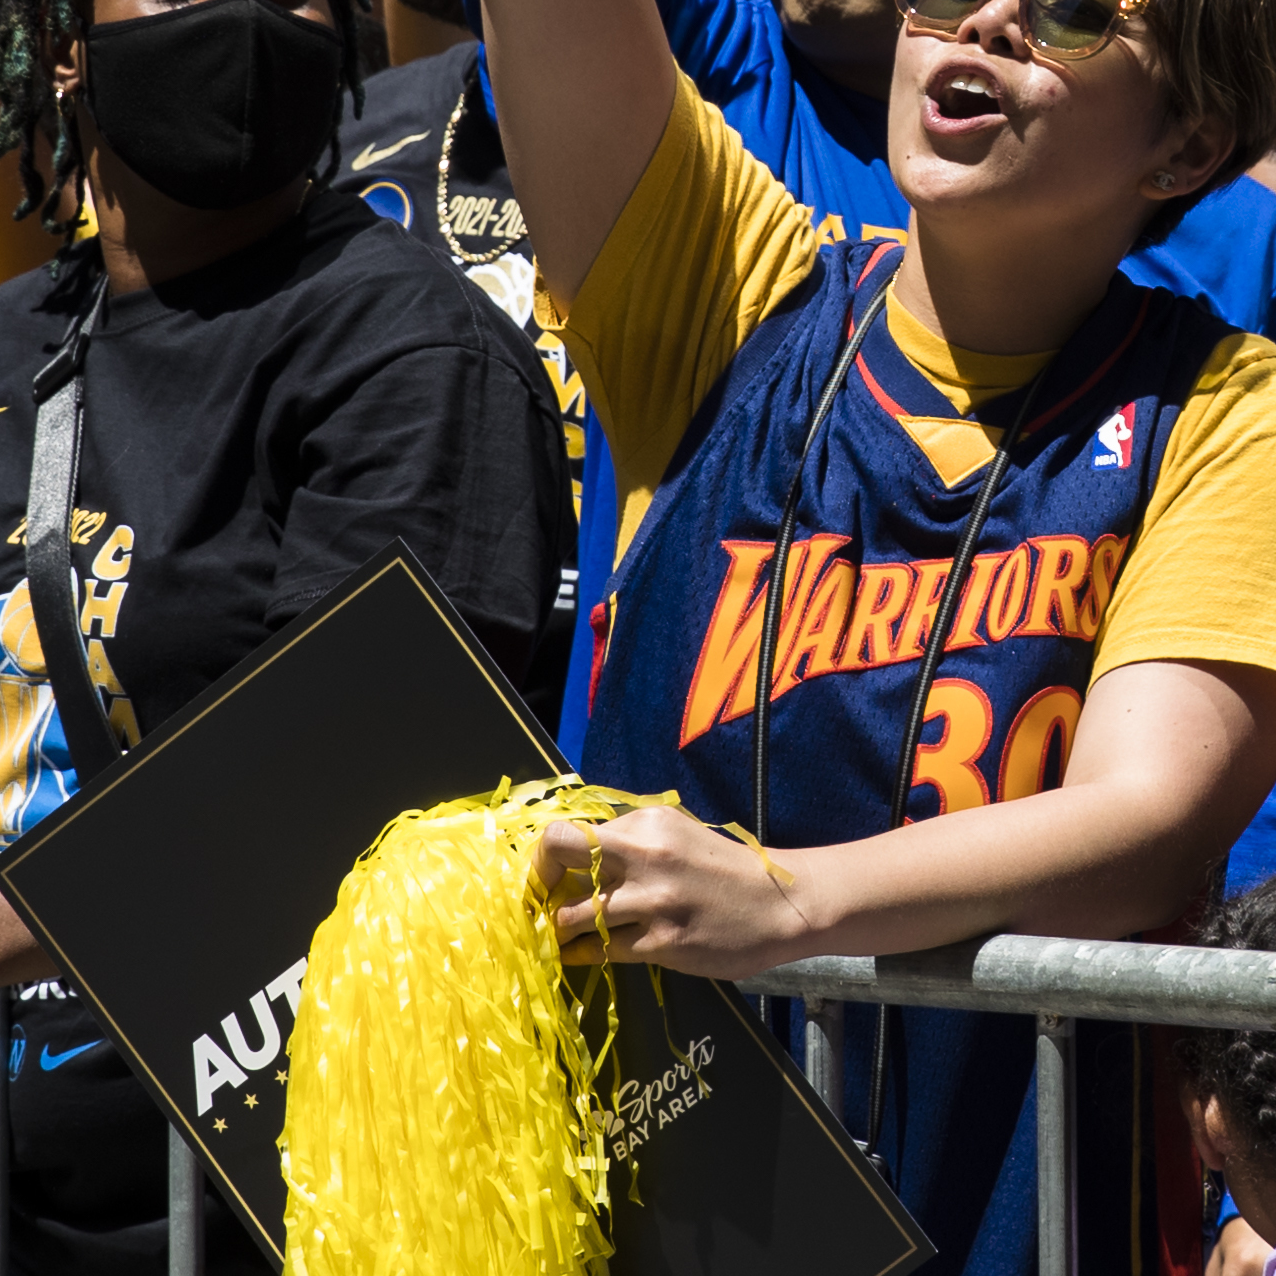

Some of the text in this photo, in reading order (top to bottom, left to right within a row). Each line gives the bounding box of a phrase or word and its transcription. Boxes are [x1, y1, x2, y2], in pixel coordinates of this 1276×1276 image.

[448, 194, 527, 238] 2021-20
[1094, 454, 1117, 466] NBA
[679, 533, 1132, 751] WARRIORS
[903, 677, 1088, 826] 30
[192, 956, 309, 1117] AUT
[617, 1035, 716, 1124] Sports
[612, 1080, 713, 1162] BAY AREA
